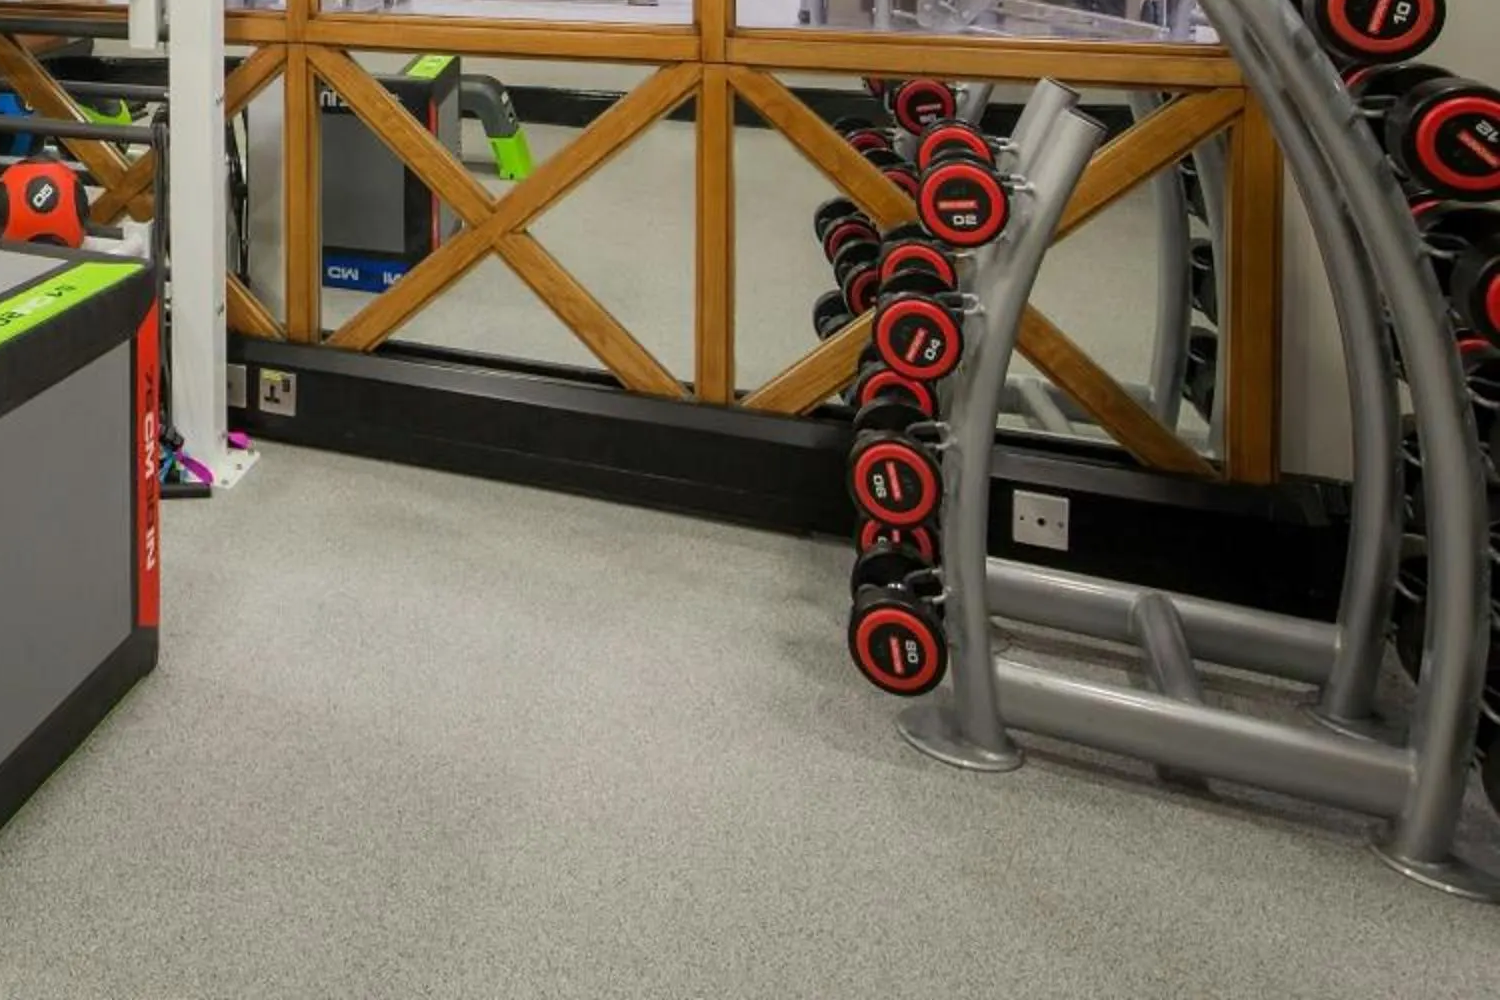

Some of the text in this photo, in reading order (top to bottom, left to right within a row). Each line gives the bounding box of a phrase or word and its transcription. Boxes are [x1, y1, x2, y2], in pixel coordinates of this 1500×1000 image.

[1393, 1, 1412, 25] 10
[953, 214, 978, 226] 02
[924, 337, 942, 362] 04
